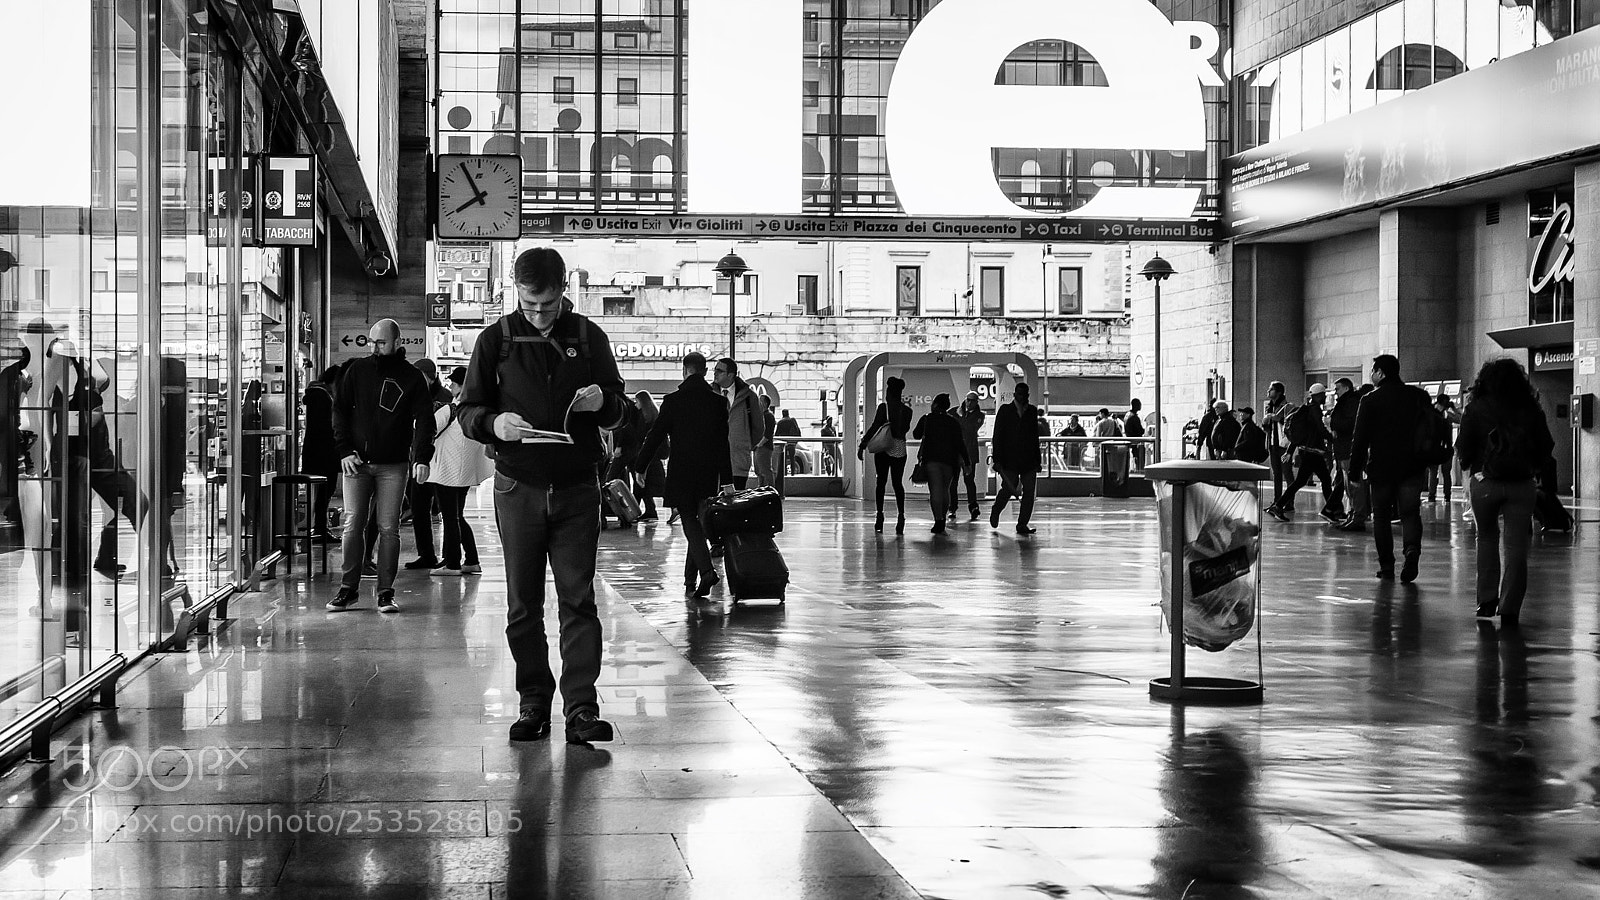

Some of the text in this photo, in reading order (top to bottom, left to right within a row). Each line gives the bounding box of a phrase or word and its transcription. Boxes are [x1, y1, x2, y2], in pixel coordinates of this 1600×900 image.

[269, 157, 310, 216] T
[596, 217, 743, 231] Uscita Exit Via Giolitti
[784, 219, 1018, 236] Uscita Exit Piazza dei Cinquecento
[1052, 223, 1082, 235] Taxi
[1126, 224, 1214, 236] Terminal Bus
[265, 227, 313, 239] TABACCHI
